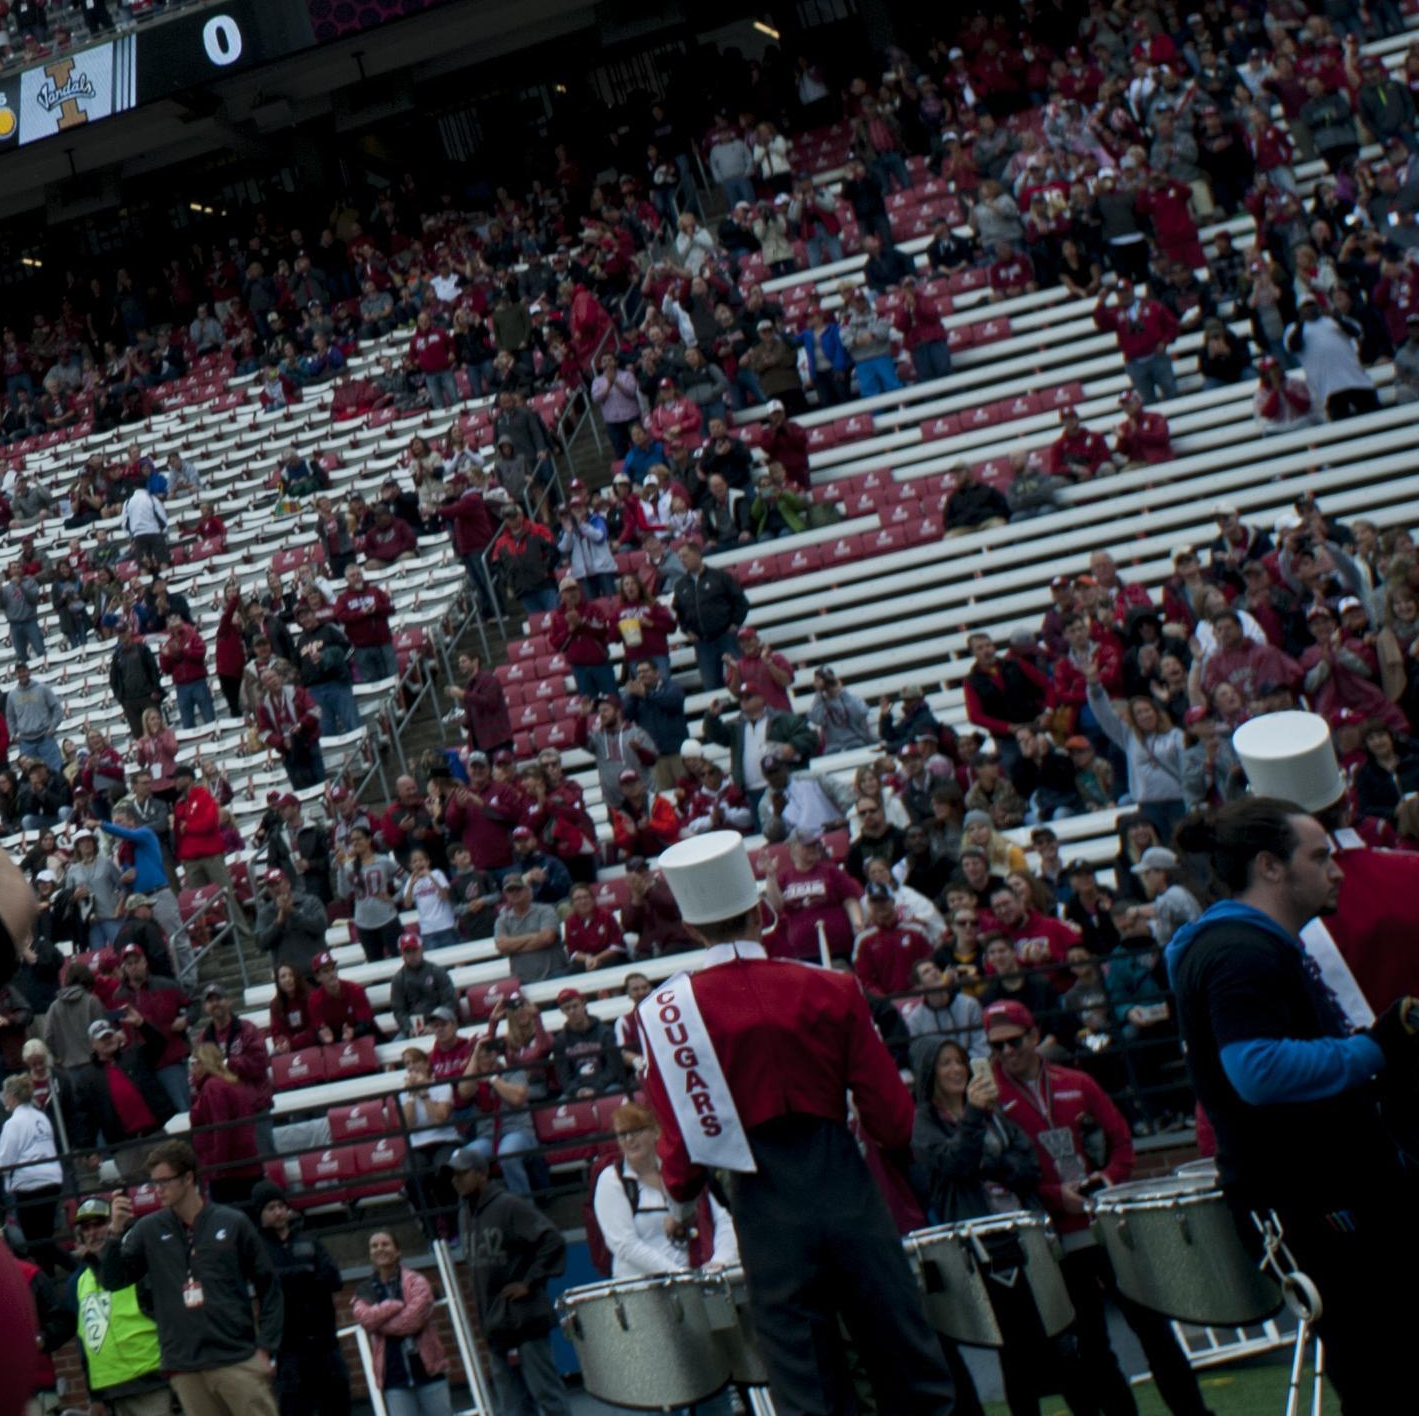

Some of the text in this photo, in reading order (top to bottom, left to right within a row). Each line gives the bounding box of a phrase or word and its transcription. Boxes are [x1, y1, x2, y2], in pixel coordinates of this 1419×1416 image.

[202, 13, 243, 67] 0
[36, 74, 96, 111] Vandals
[656, 990, 723, 1138] COUGARS
